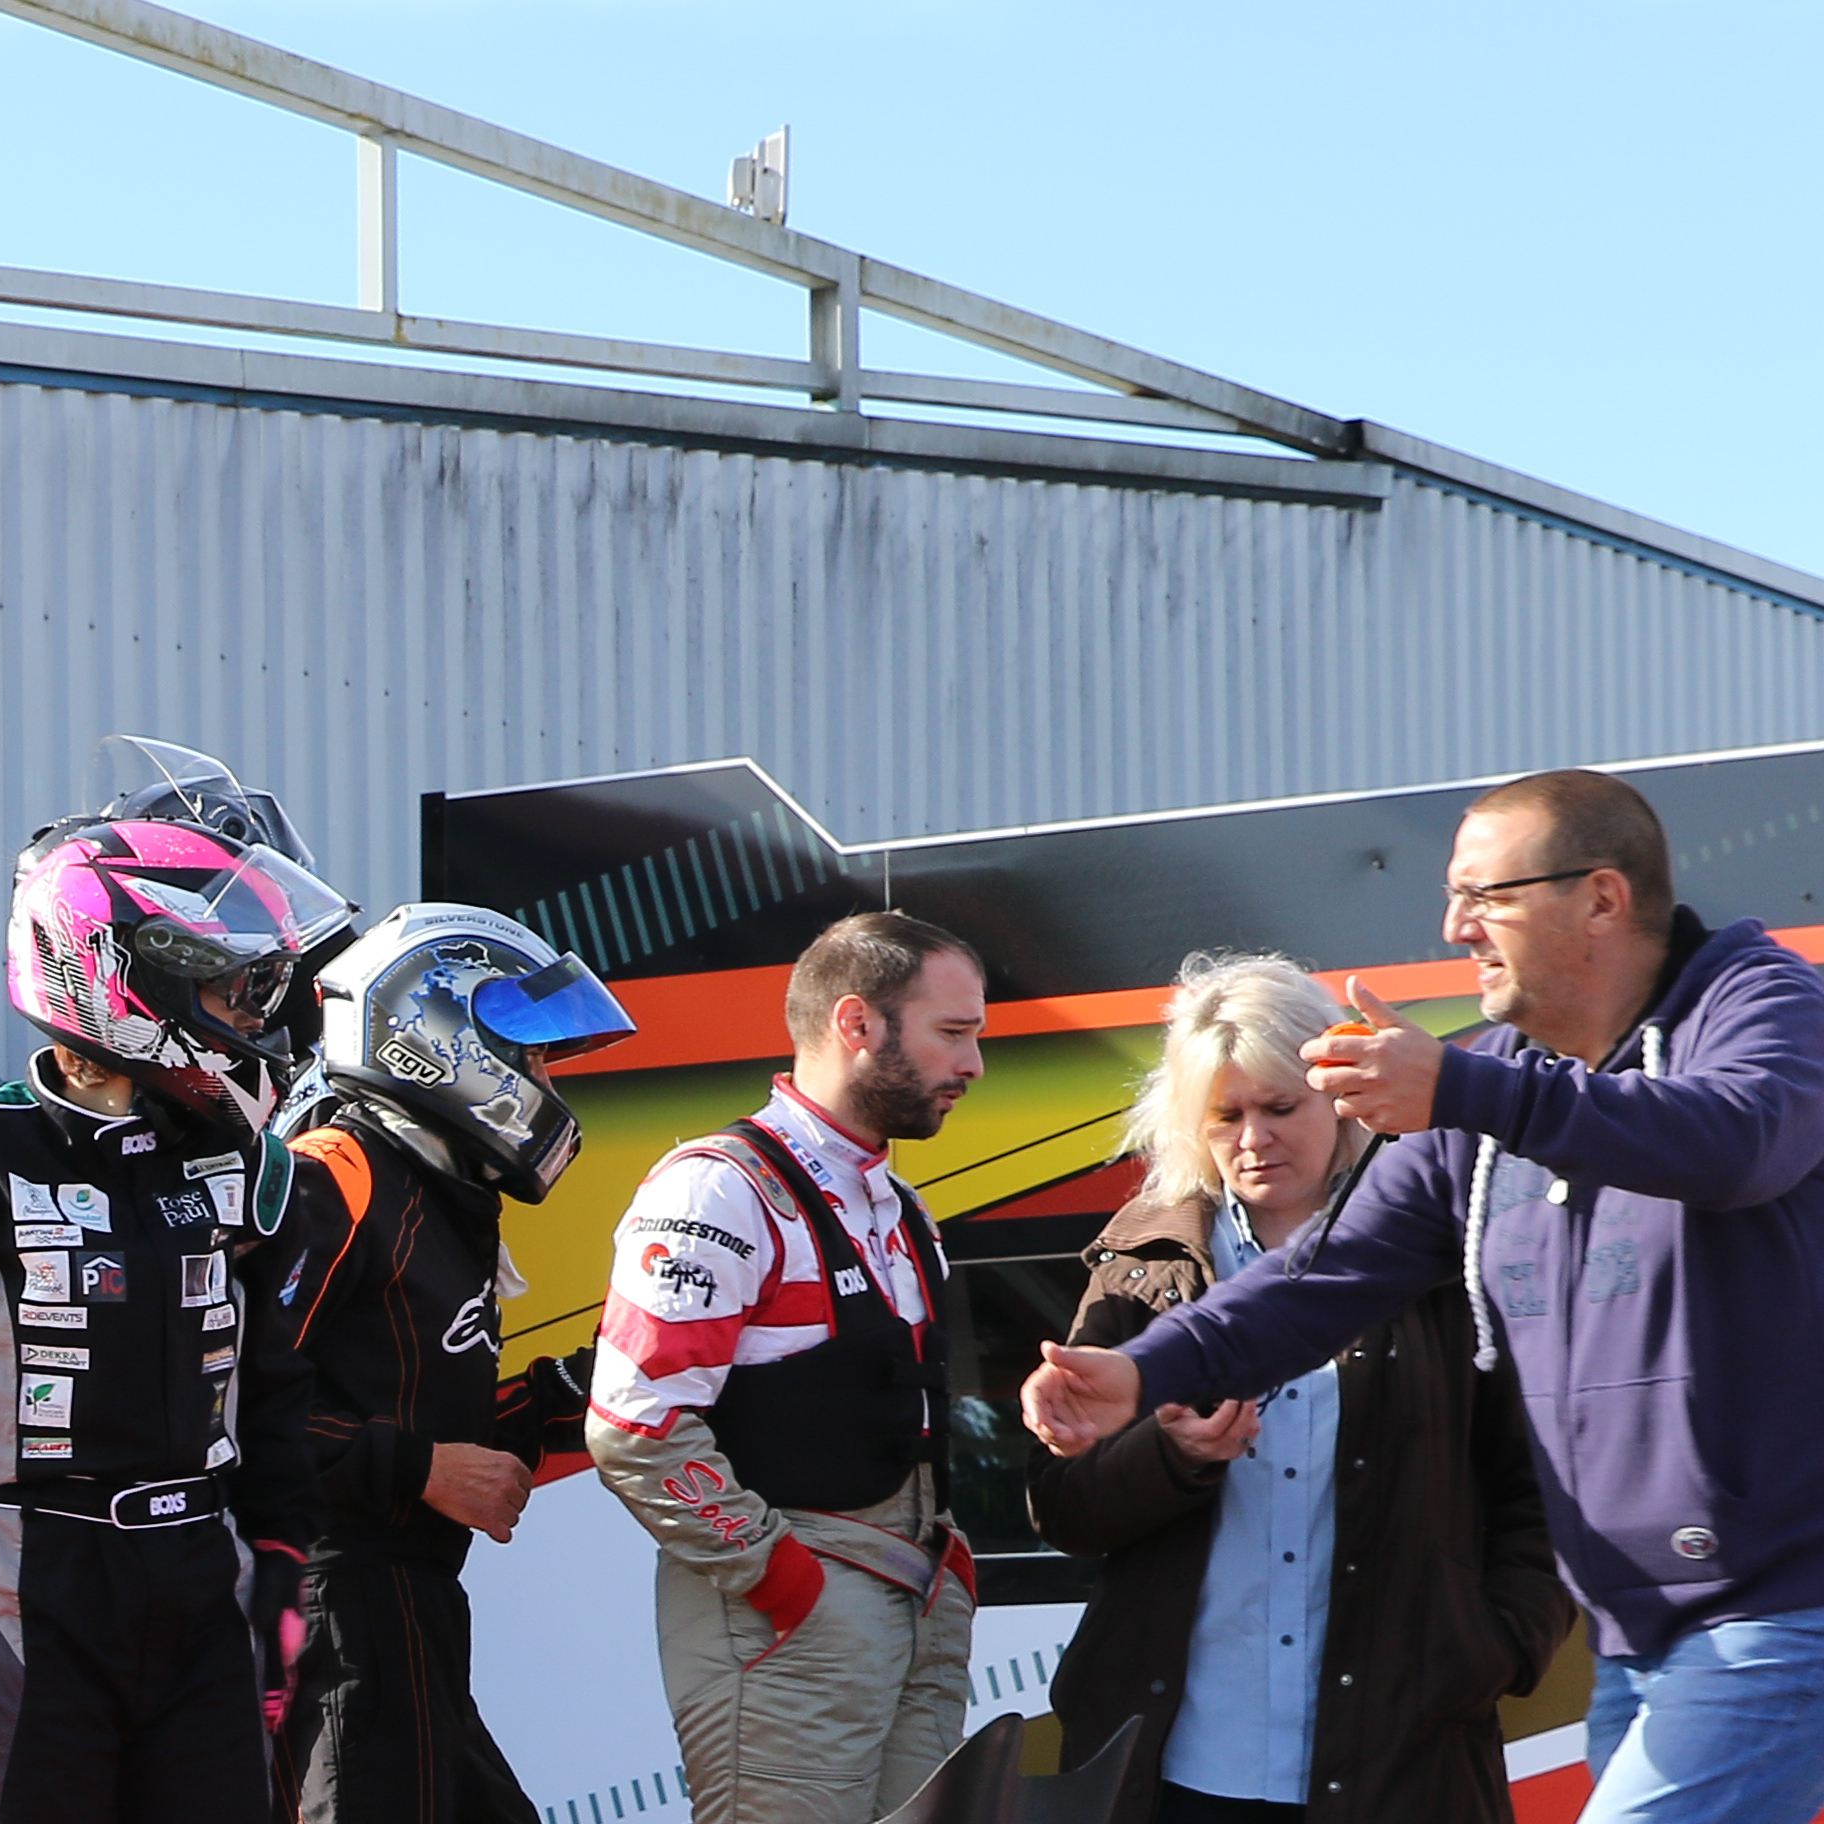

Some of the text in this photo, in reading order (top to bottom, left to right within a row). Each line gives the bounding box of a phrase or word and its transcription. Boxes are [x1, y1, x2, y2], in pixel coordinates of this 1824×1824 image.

[387, 1047, 438, 1081] agv
[121, 1131, 157, 1156] BOXS
[157, 1190, 203, 1212] rose
[162, 1202, 212, 1228] Paul
[40, 1351, 79, 1361] DEKRA
[149, 1491, 187, 1516] BOXS
